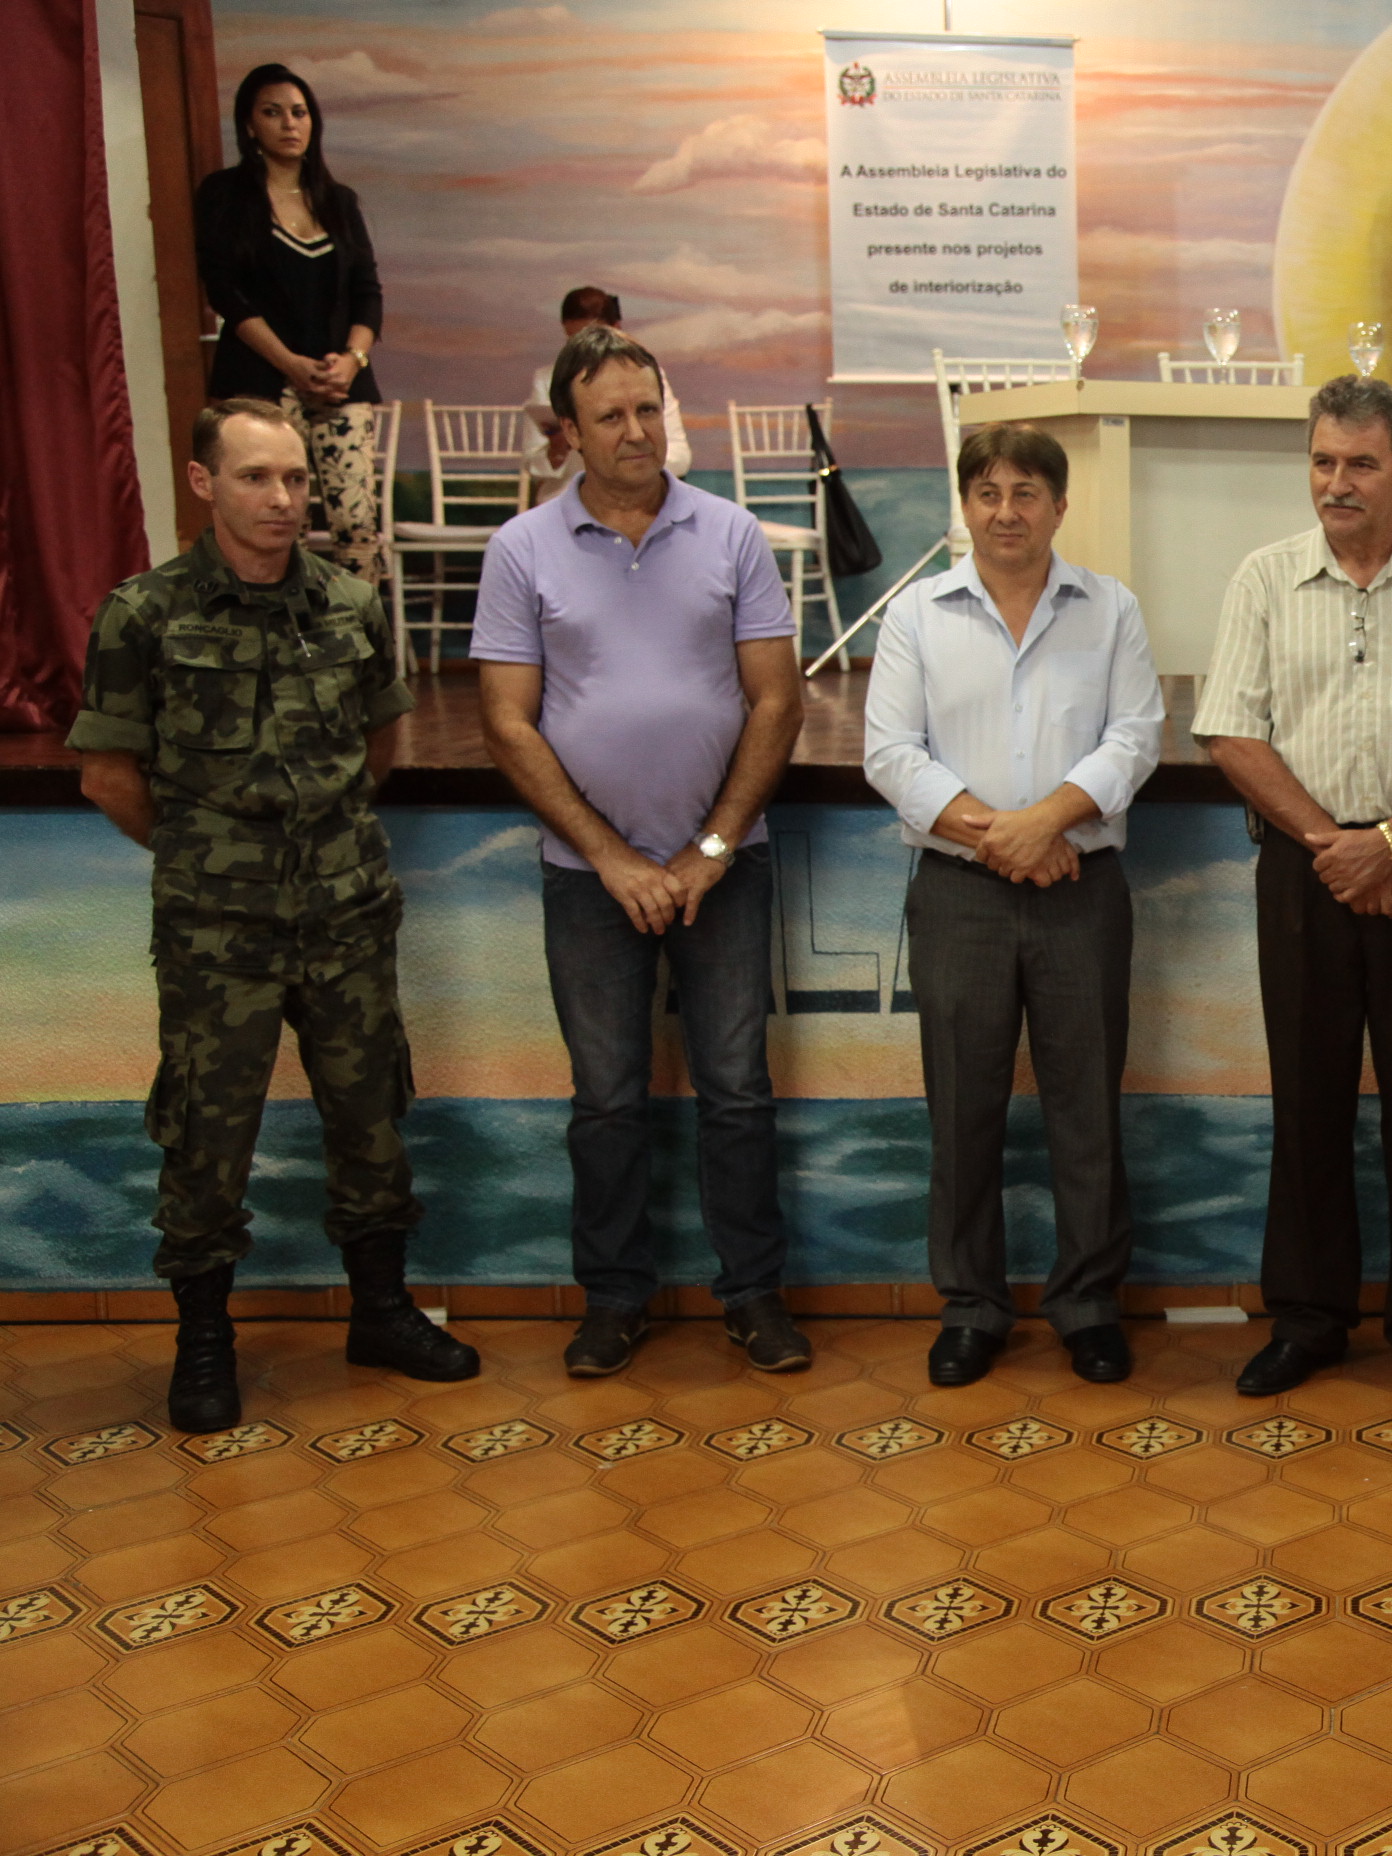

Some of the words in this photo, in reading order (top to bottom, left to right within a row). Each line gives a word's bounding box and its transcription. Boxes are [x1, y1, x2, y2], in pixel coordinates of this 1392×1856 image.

[884, 71, 968, 85] ASSEMBLEIA
[973, 71, 1061, 86] LEGISLATIVA
[840, 164, 853, 178] A
[855, 164, 950, 179] Assembleia
[954, 164, 1042, 182] Legislativa
[1045, 165, 1068, 179] do
[852, 202, 909, 218] Estado
[913, 203, 933, 217] de
[938, 202, 984, 217] Santa
[988, 202, 1057, 218] Catarina
[866, 243, 938, 258] presente
[941, 244, 972, 256] nos
[976, 242, 1044, 259] projetos
[888, 280, 910, 295] de
[912, 280, 1024, 296] interiorização
